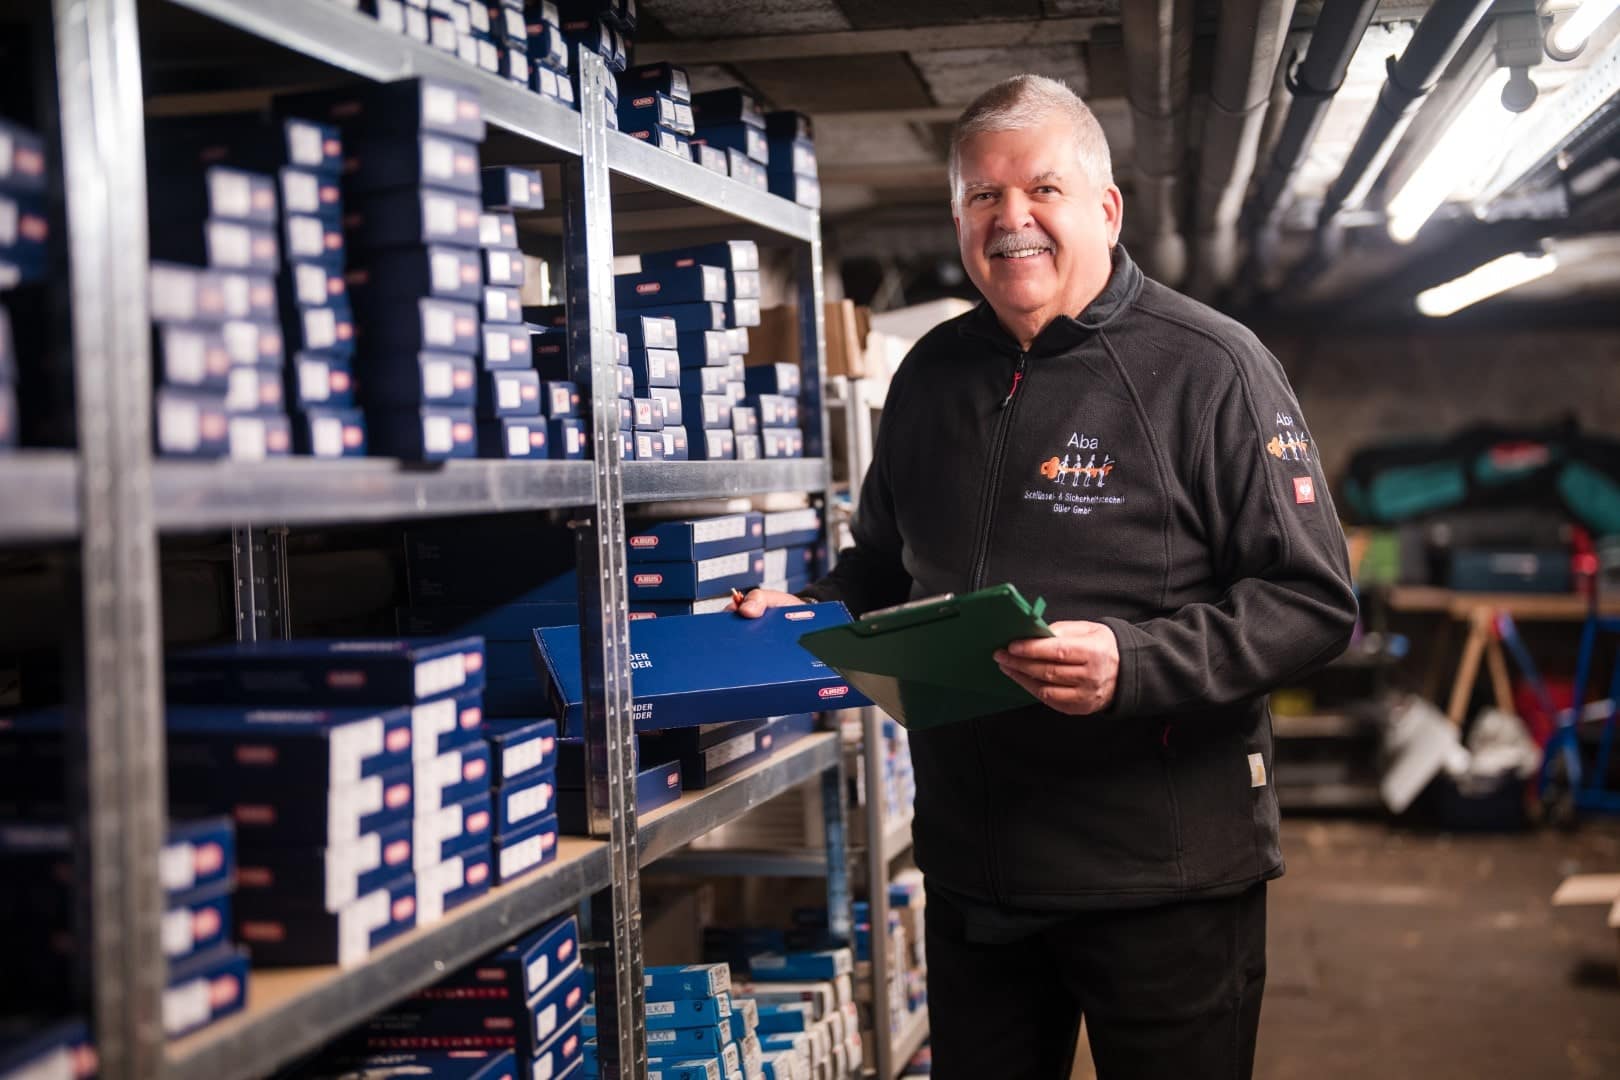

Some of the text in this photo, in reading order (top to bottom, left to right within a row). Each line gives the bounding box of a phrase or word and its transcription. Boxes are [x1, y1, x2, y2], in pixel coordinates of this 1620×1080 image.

[1067, 432, 1099, 449] Aba
[632, 536, 657, 546] ABUS
[636, 575, 661, 584] ABUS
[628, 652, 649, 661] DER
[631, 660, 653, 669] DER
[820, 686, 847, 696] ABUS
[632, 703, 653, 712] NDER
